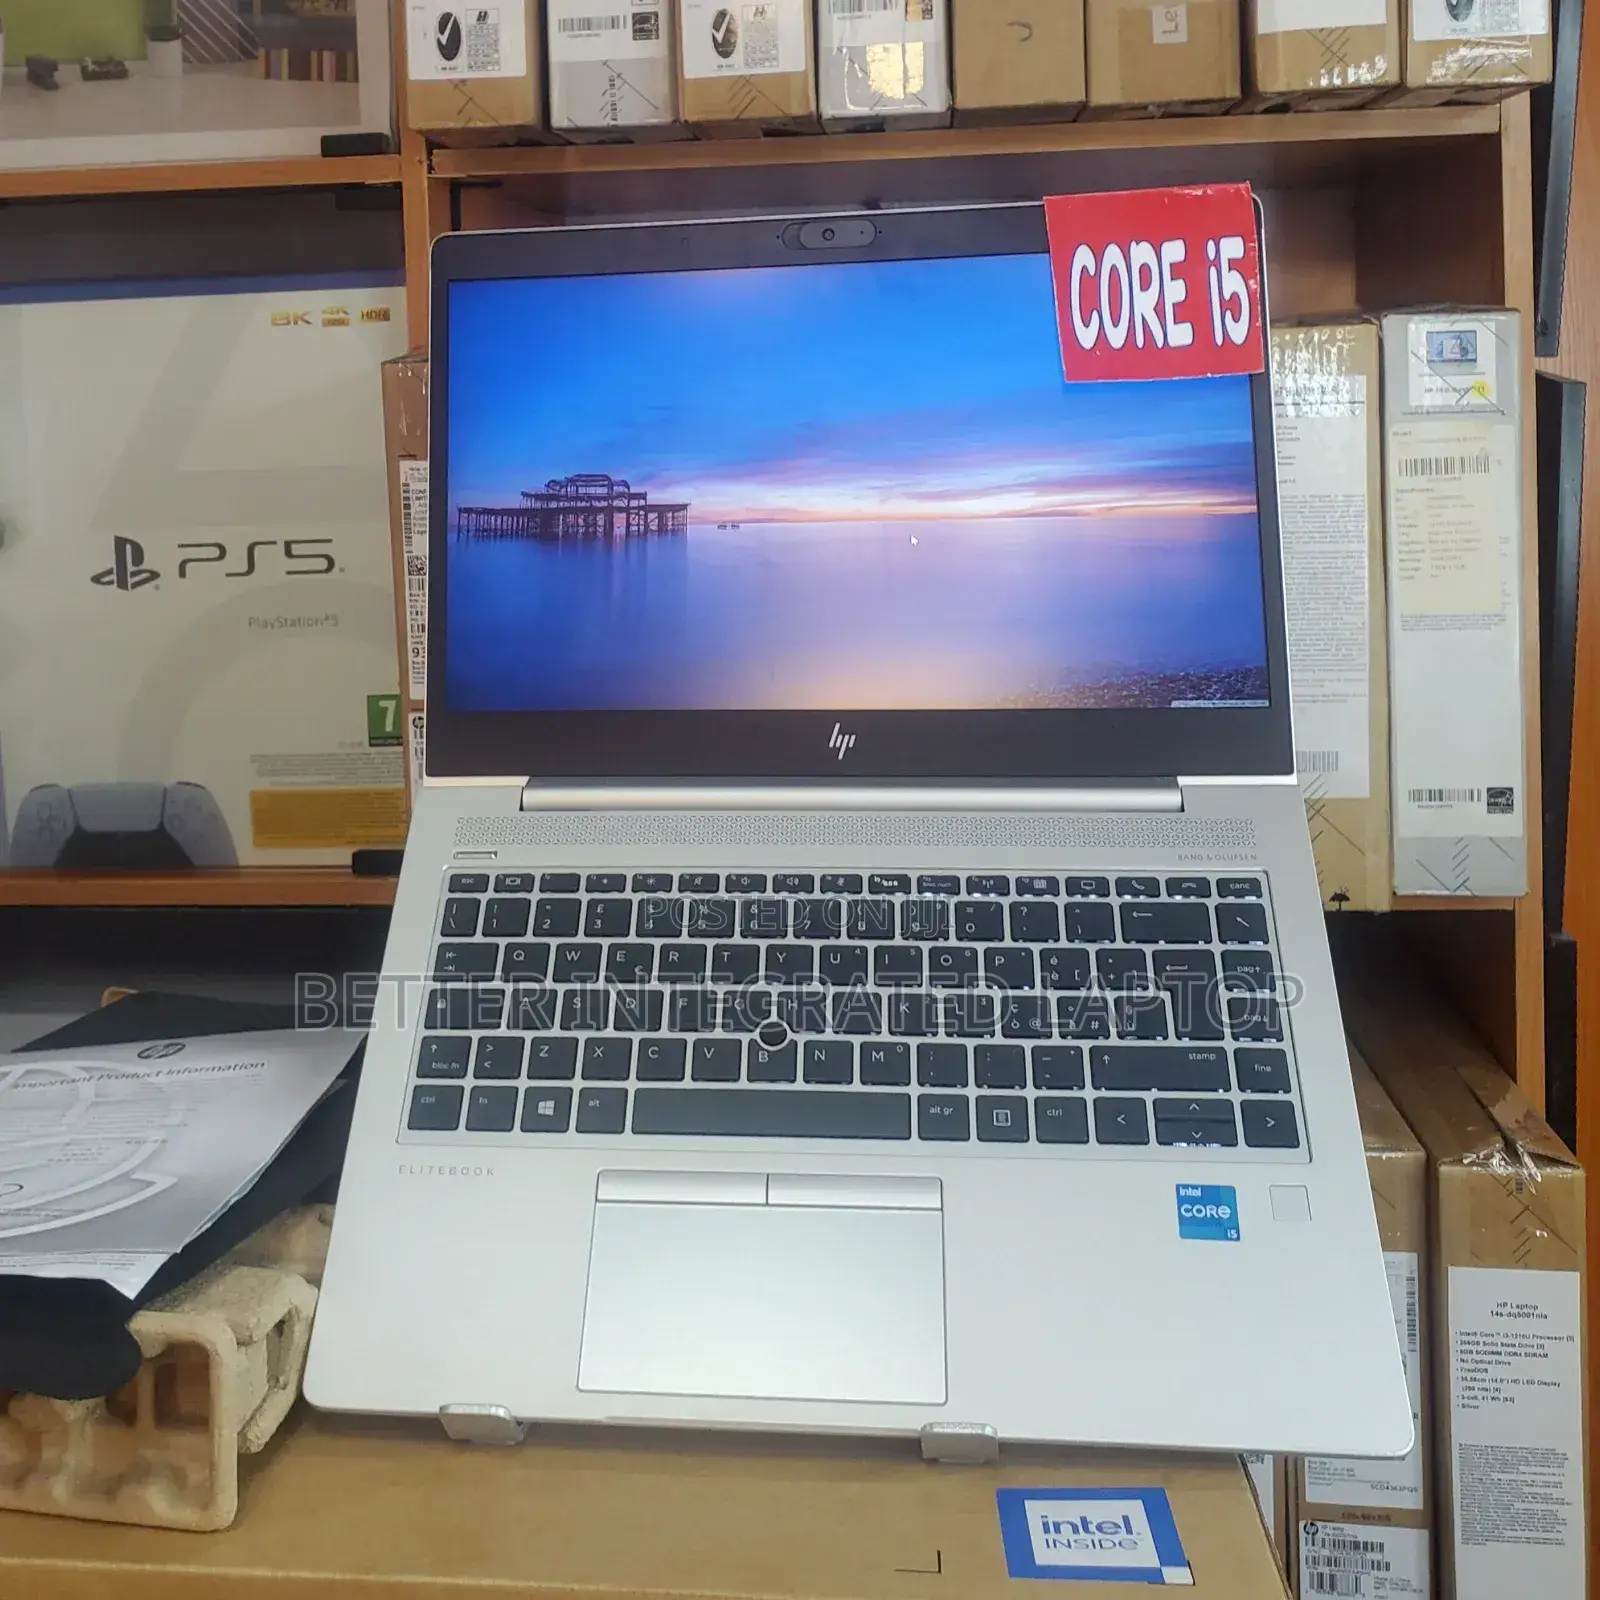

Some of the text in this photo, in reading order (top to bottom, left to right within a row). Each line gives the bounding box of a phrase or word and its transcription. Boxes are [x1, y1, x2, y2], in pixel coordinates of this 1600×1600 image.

[1070, 235, 1251, 350] CORE i5
[271, 311, 313, 326] 8K
[177, 538, 335, 579] PS5
[378, 700, 396, 732] 7
[829, 722, 856, 760] hp
[492, 919, 497, 928] 1
[542, 918, 551, 929] 2
[593, 919, 602, 929] 3
[513, 950, 525, 961] Q
[566, 950, 581, 961] W
[616, 950, 626, 962] E
[668, 951, 679, 962] R
[721, 951, 731, 962] T
[776, 952, 786, 963] Y
[830, 953, 840, 964] U
[940, 955, 953, 966] O
[995, 956, 1005, 967] P
[1237, 965, 1254, 973] pag
[520, 997, 530, 1009] A
[572, 997, 581, 1009] S
[626, 998, 636, 1009] D
[678, 998, 688, 1009] F
[788, 1000, 798, 1011] H
[899, 1002, 911, 1013] K
[955, 1004, 964, 1015] L
[1029, 1018, 1041, 1029] @
[1090, 1020, 1100, 1030] #
[538, 1045, 549, 1058] Z
[592, 1046, 604, 1058] X
[648, 1046, 659, 1058] C
[703, 1047, 715, 1059] V
[758, 1051, 768, 1063] B
[814, 1049, 826, 1061] N
[871, 1050, 884, 1063] M
[1188, 1052, 1216, 1061] stamp
[96, 1068, 163, 1083] Product
[164, 1061, 266, 1077] Information
[1254, 1063, 1272, 1072] fine
[420, 1095, 436, 1104] ctrl
[479, 1096, 488, 1104] fn
[588, 1099, 600, 1107] alt
[929, 1105, 954, 1115] alt gr
[1047, 1108, 1063, 1116] ctrl
[398, 1164, 495, 1176] ELITEBOOK
[1510, 1302, 1539, 1311] Laptop
[1470, 1358, 1493, 1366] Optical
[1537, 1380, 1561, 1388] Display
